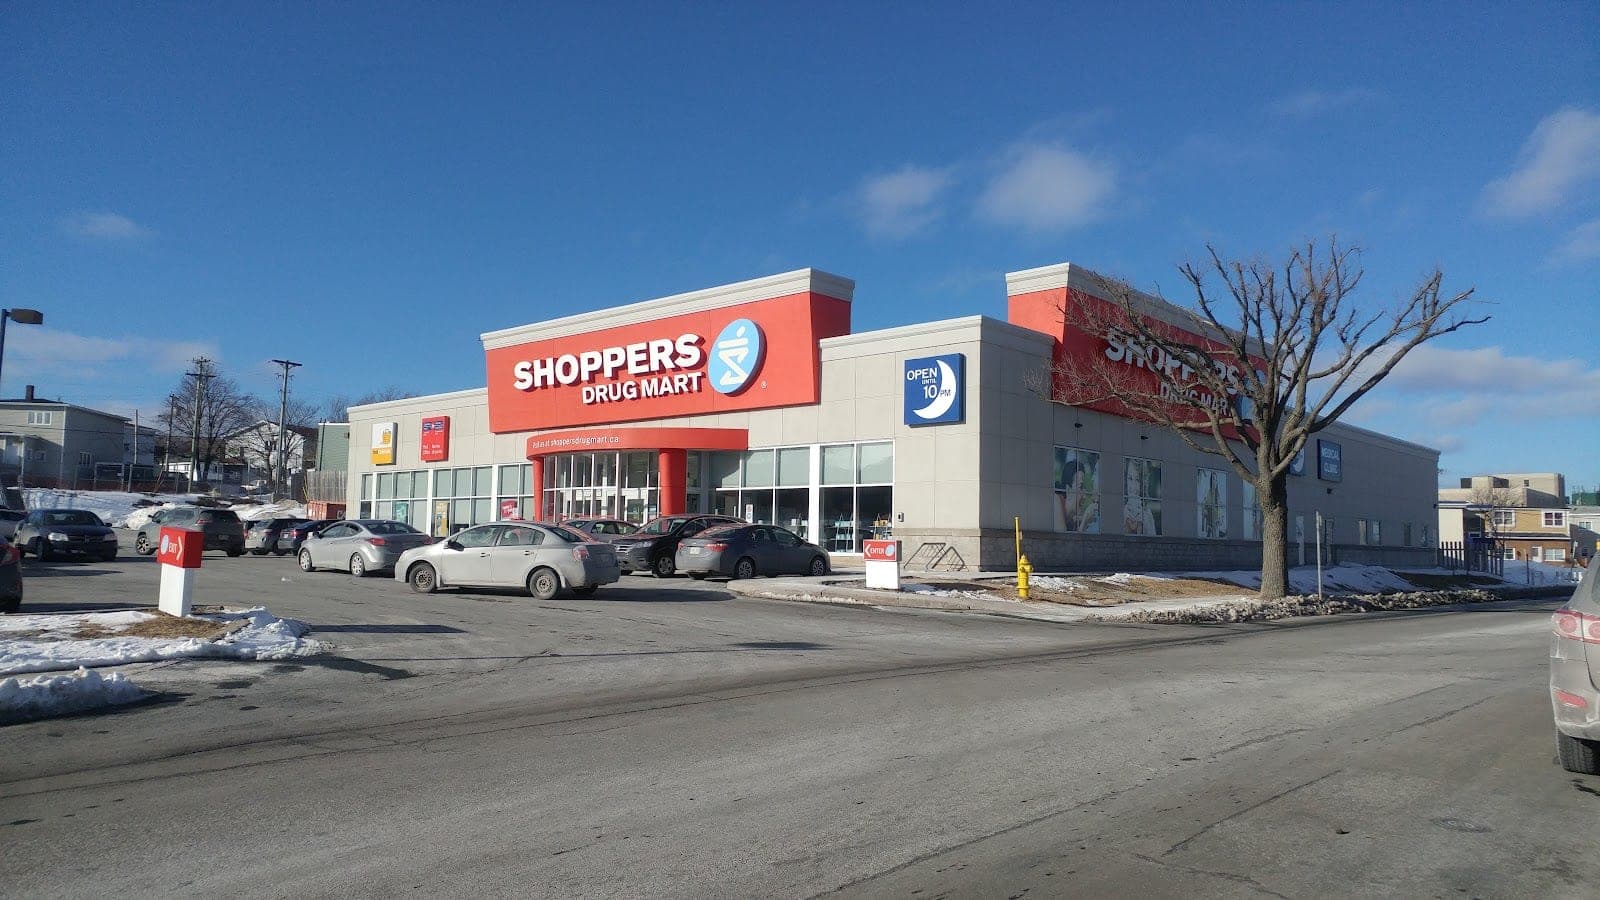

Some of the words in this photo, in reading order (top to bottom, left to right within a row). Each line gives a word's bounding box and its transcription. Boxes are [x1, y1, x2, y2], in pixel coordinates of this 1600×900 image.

[513, 333, 702, 390] SHOPPERS
[907, 368, 937, 380] OPEN
[582, 381, 637, 404] DRUG
[641, 372, 702, 398] MART
[923, 385, 938, 399] 10
[940, 389, 951, 397] PM
[551, 436, 619, 446] shoppersdrugmart.ca
[168, 542, 178, 553] EXIT
[870, 547, 885, 555] ENTER
